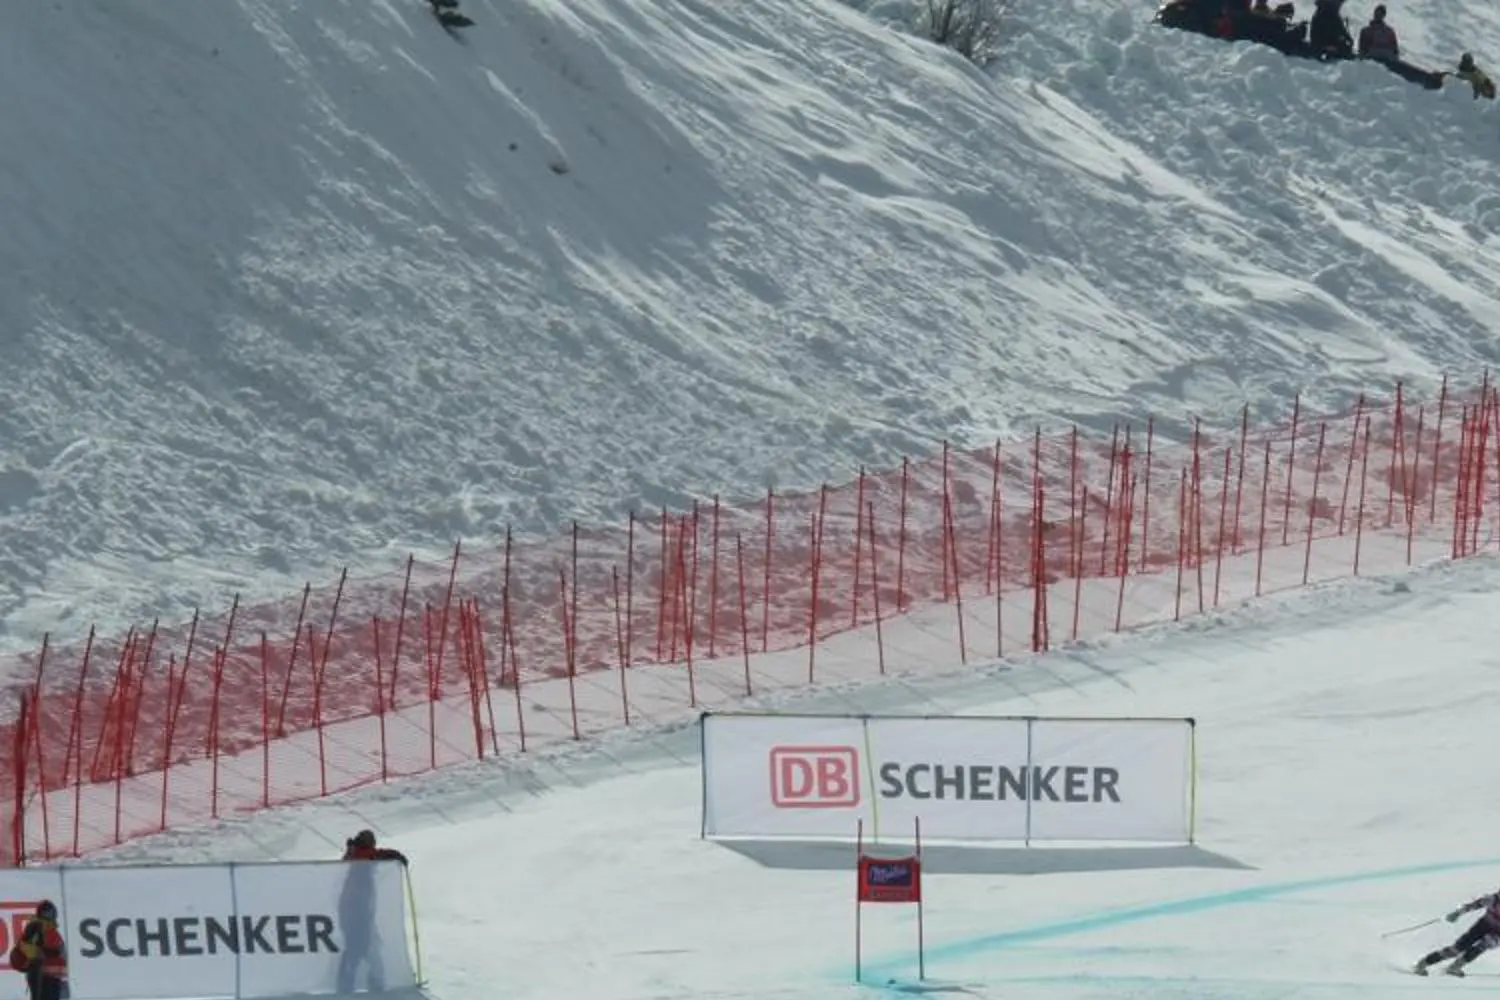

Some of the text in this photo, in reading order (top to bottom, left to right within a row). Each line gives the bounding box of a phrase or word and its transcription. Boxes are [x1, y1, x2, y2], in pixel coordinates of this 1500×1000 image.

[781, 757, 1122, 803] DB SCHENKER
[79, 914, 340, 959] SCHENKER
